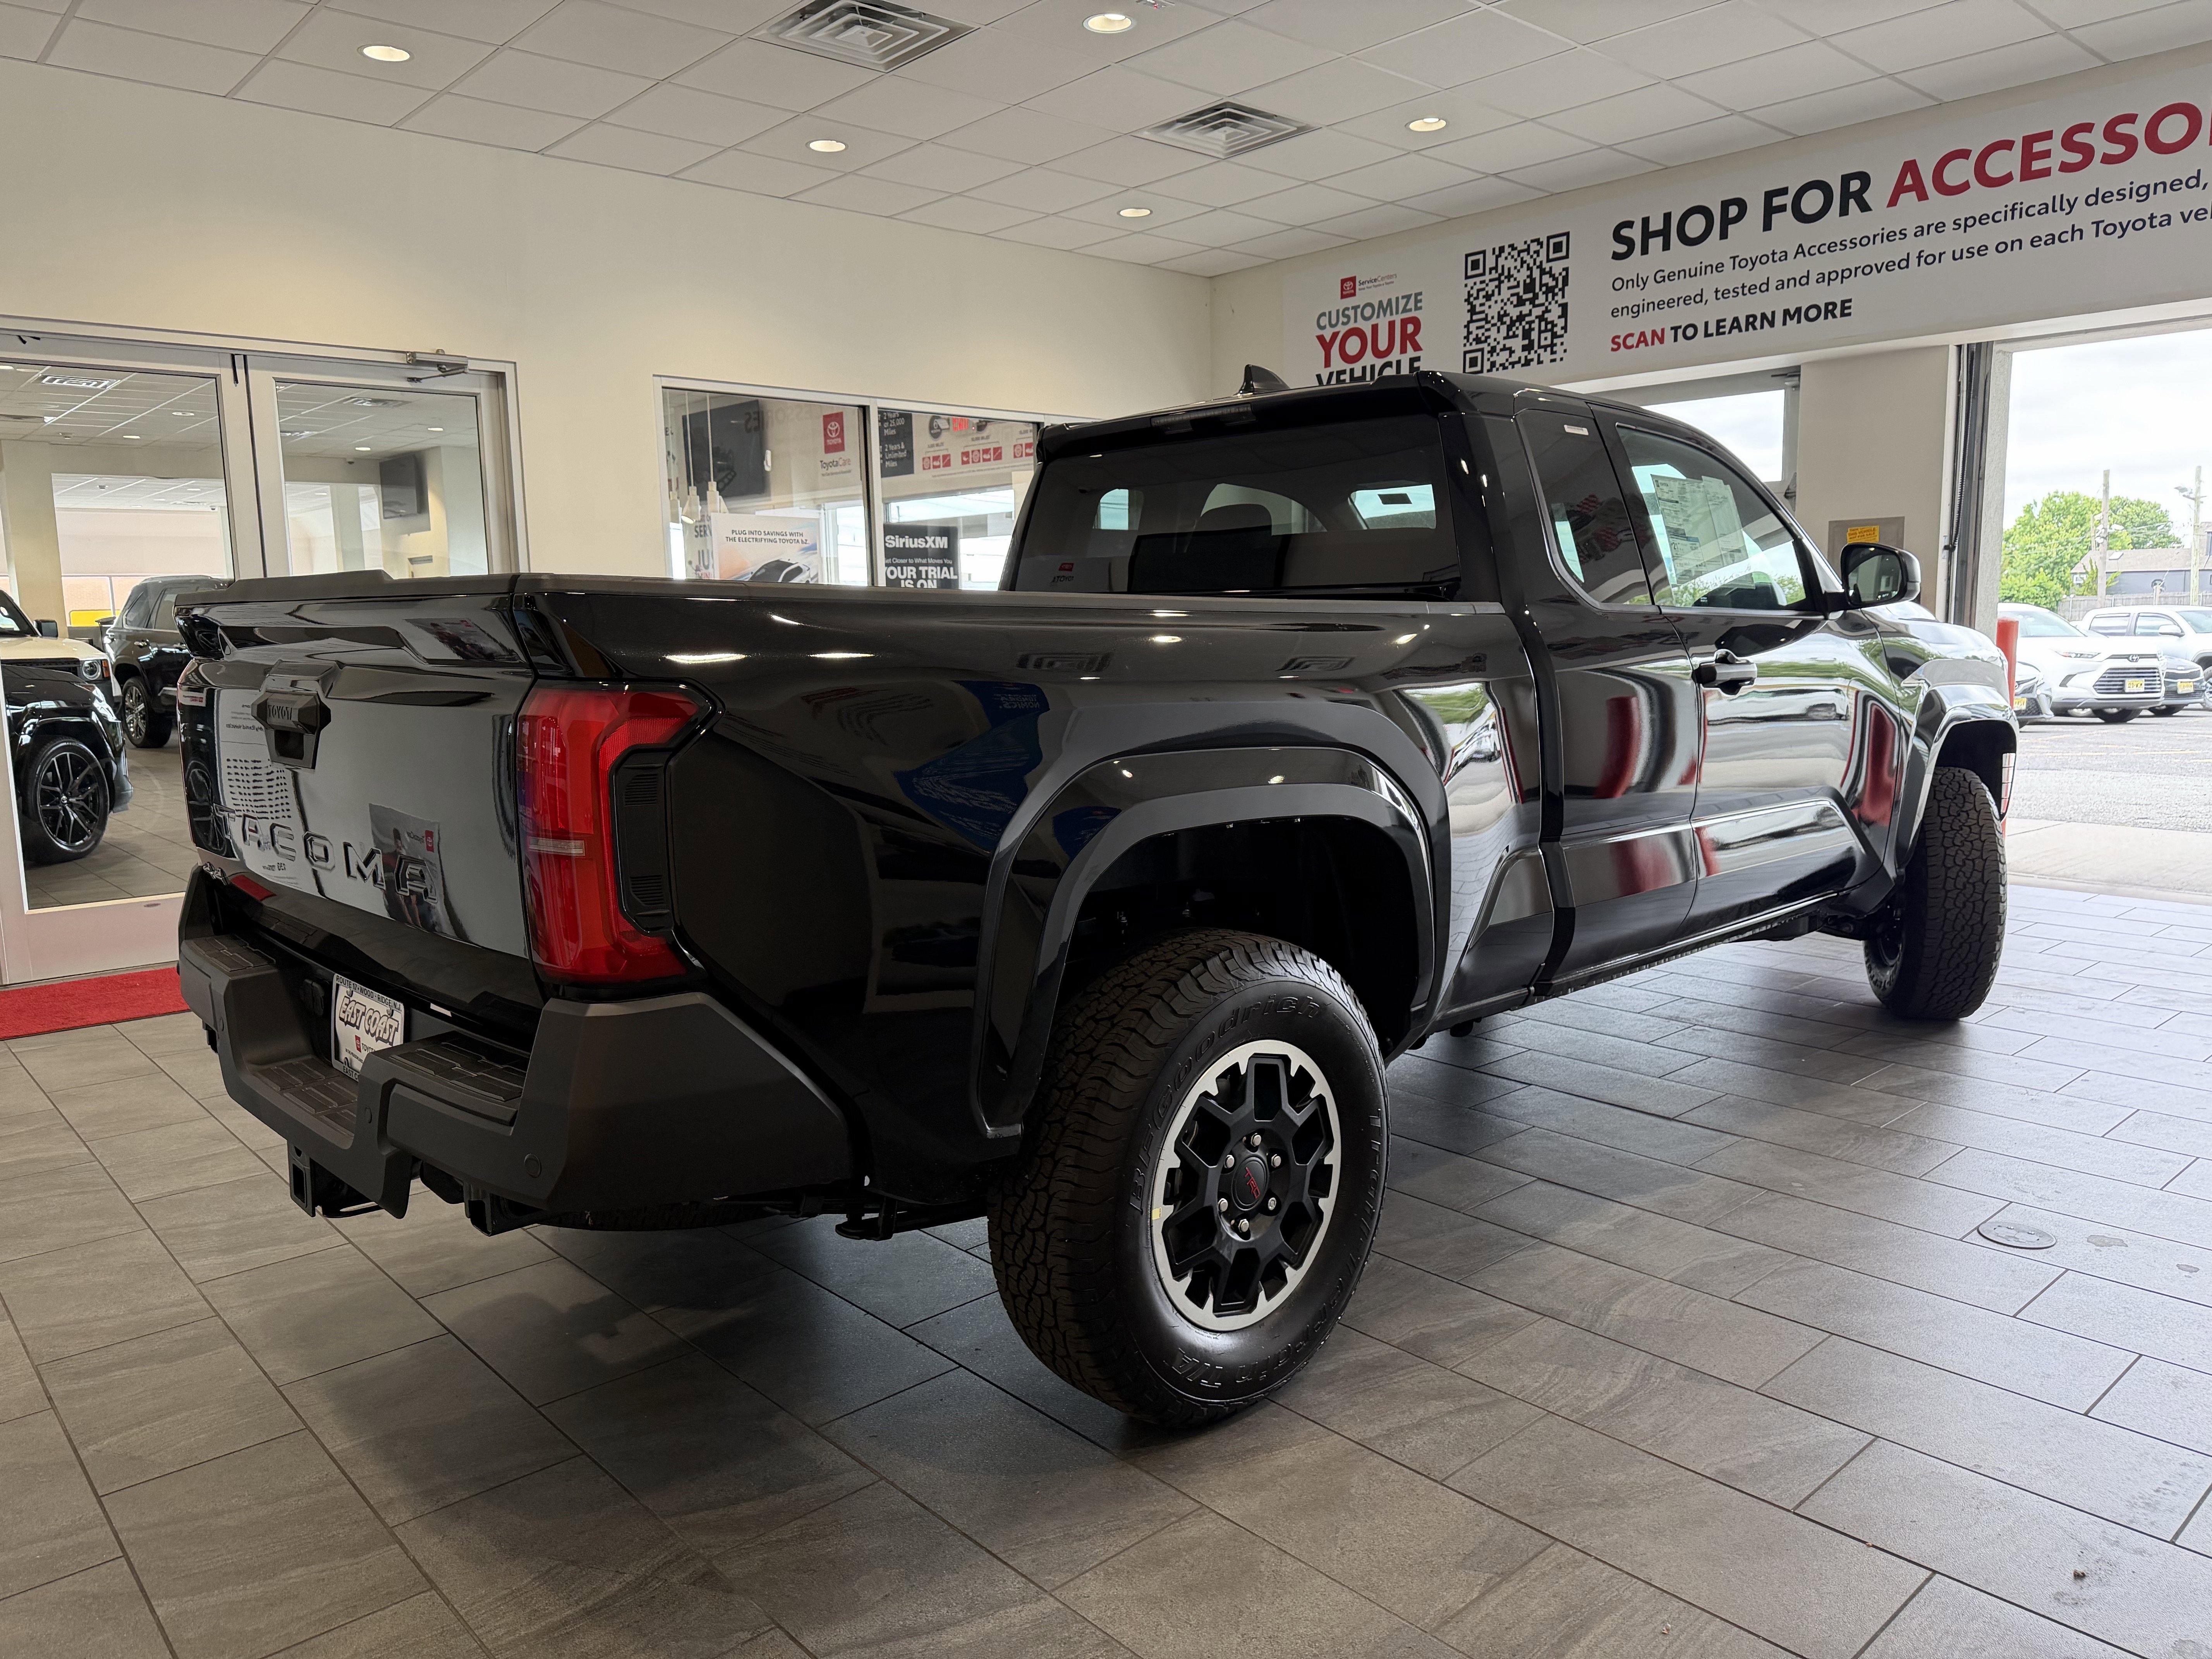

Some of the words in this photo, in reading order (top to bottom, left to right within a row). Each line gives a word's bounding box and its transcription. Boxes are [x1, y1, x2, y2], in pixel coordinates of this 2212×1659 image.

[1611, 197, 1748, 261] SHOP
[1762, 170, 1873, 232] FOR
[1886, 101, 2212, 208] ACCESSO
[1612, 273, 1649, 292] Only
[1654, 261, 1724, 284] Genuine
[1729, 249, 1788, 272] Toyota
[1793, 227, 1907, 259] Accessories
[1914, 220, 1946, 238] are
[1952, 194, 2079, 233] specifically
[2085, 169, 2209, 207] designed,
[1611, 289, 1709, 319] engineered,
[1714, 277, 1770, 301] tested
[1775, 270, 1810, 290] and
[1816, 252, 1910, 287] approved
[1917, 249, 1946, 268] for
[1951, 242, 1989, 261] use
[1995, 237, 2023, 254] on
[2030, 223, 2084, 248] each
[2091, 212, 2172, 240] Toyota
[2179, 201, 2212, 223] ve
[1317, 291, 1422, 330] CUSTOMIZE
[1610, 327, 1665, 352] SCAN
[1670, 323, 1698, 343] TO
[1704, 310, 1776, 338] LEARN
[1782, 298, 1853, 327] MORE
[1316, 316, 1423, 368] YOUR
[885, 535, 948, 548] SiriusXM
[885, 566, 916, 579] OUR
[919, 567, 958, 579] TRIAL
[917, 580, 937, 588] ON
[213, 803, 438, 903] TACOMA
[336, 975, 352, 987] ROUTE
[360, 986, 373, 998] WOOD
[339, 996, 366, 1030] EAST
[364, 1008, 399, 1046] COAST
[343, 1066, 353, 1077] EAST
[1130, 993, 1320, 1215] BFGoodrich
[1245, 1166, 1261, 1199] TRD
